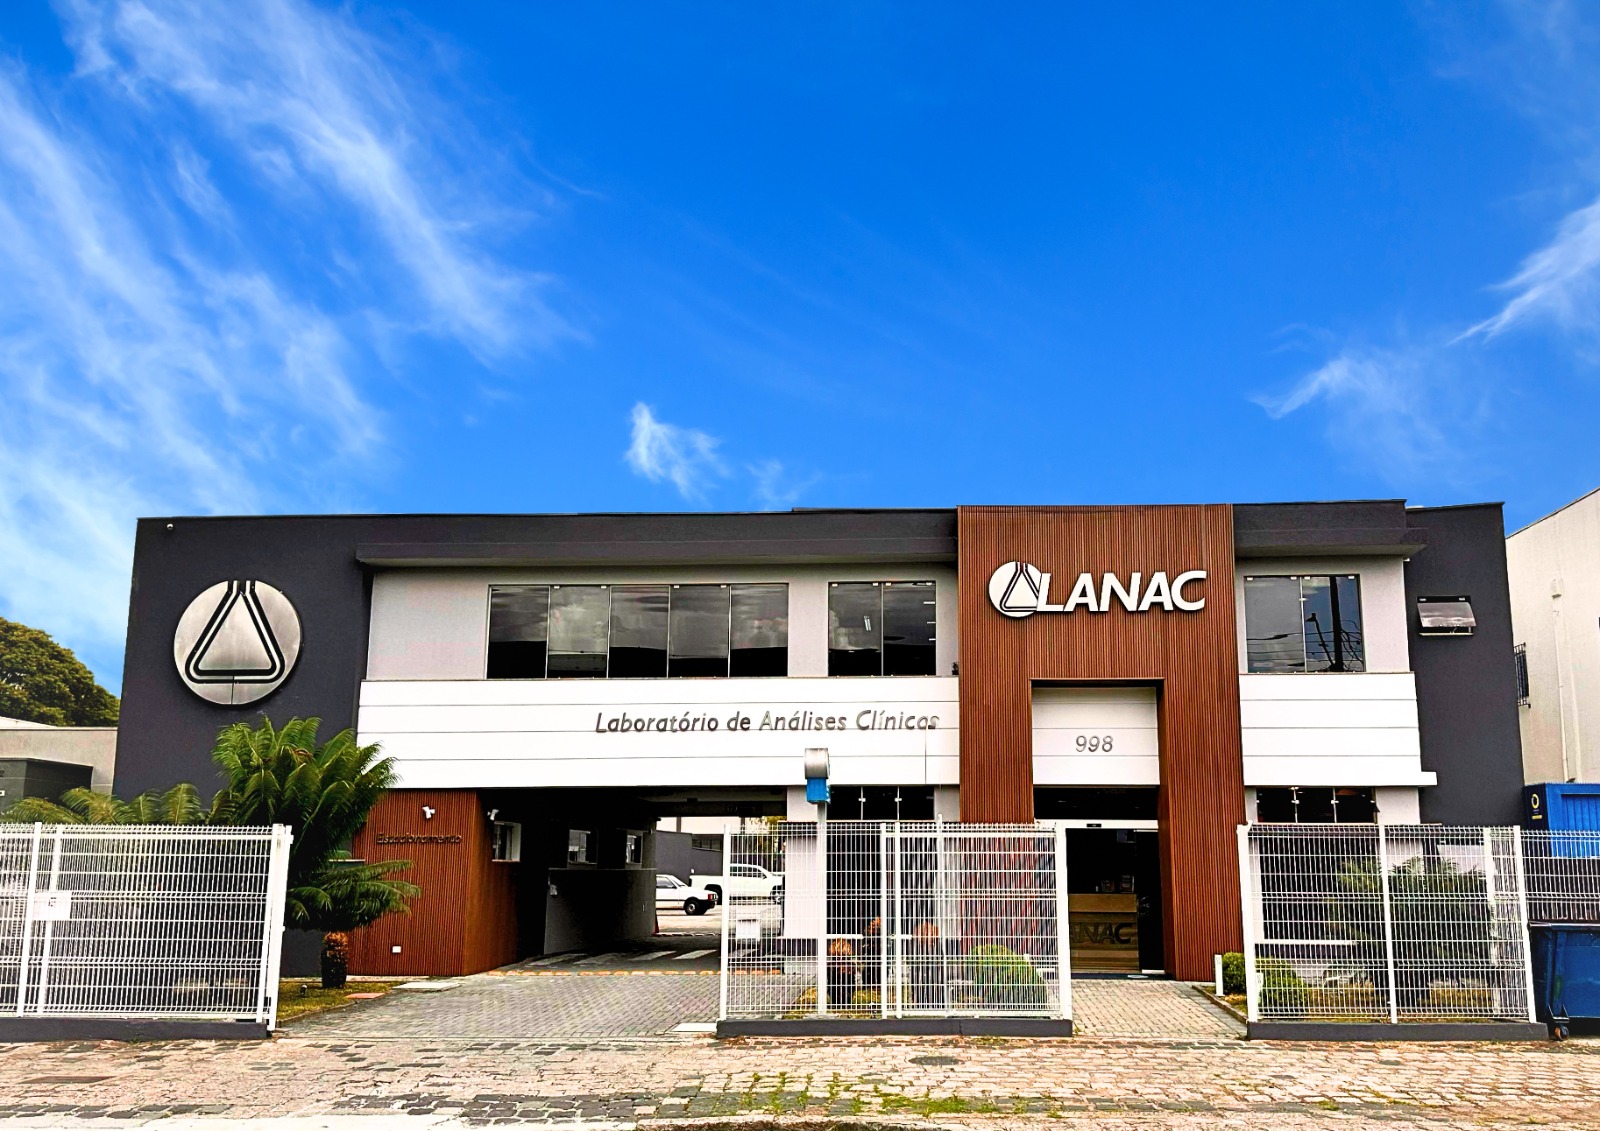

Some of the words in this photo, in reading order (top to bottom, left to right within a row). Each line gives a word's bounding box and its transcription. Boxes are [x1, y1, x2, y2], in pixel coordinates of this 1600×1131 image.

[1036, 570, 1207, 612] LANAC
[595, 711, 719, 733] Laboratório
[726, 711, 751, 731] de
[758, 710, 847, 731] Análises
[856, 709, 940, 731] Clínicas
[1075, 735, 1114, 752] 998
[376, 832, 462, 845] Estacionamento
